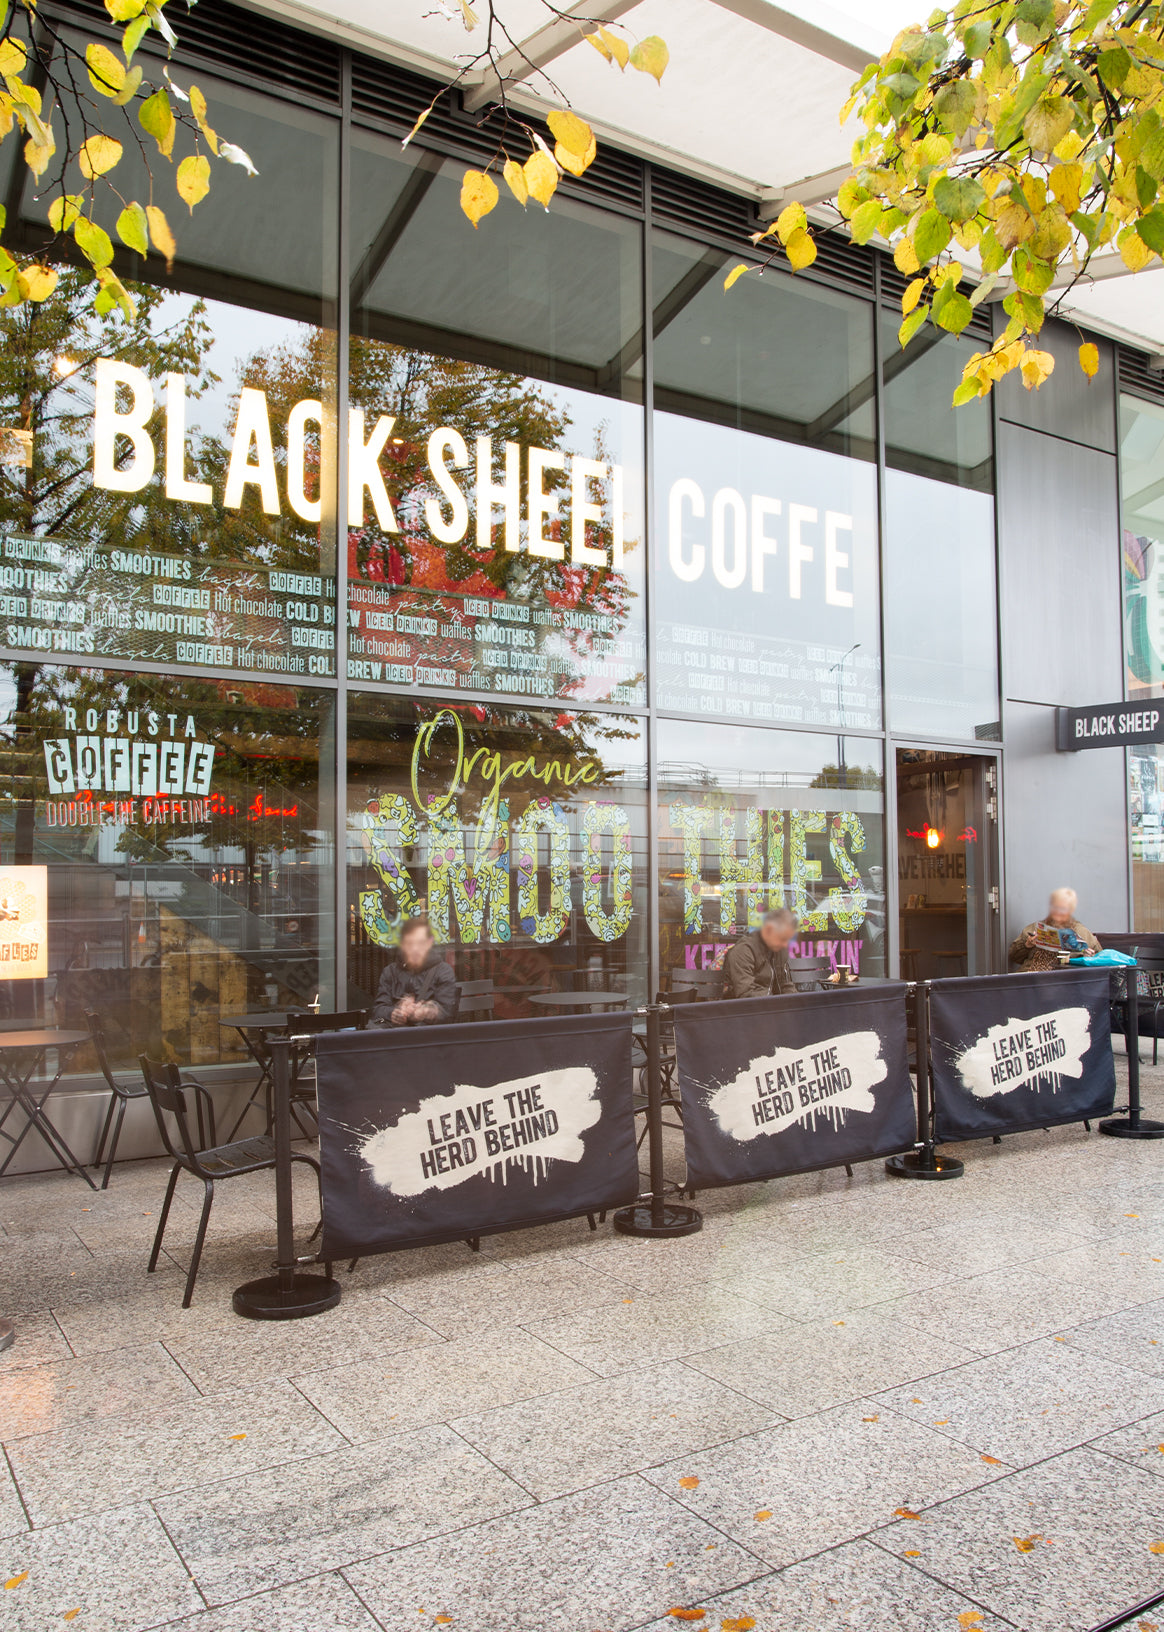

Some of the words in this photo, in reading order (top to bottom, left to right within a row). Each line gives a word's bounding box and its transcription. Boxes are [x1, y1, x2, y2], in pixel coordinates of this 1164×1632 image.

[93, 357, 399, 533] BLACK
[110, 550, 192, 580] SMOOTHIES
[196, 566, 266, 594] bagels
[269, 572, 322, 596] COFFEE
[0, 565, 68, 594] OOTHIES
[153, 584, 211, 610] COFFEE
[214, 592, 232, 613] Hot
[234, 595, 283, 618] chocolate
[286, 601, 319, 622] COLD
[365, 611, 394, 631] ICED
[396, 615, 437, 636] DRINKS
[441, 621, 472, 641] waffles
[475, 624, 536, 647] SMOOTHIES
[30, 598, 86, 624] DRINKS
[90, 606, 132, 629] waffles
[134, 610, 214, 637] SMOOTHIES
[220, 623, 287, 650] bagels
[394, 599, 461, 622] pastry
[463, 598, 490, 618] ICED
[491, 601, 530, 623] DRINKS
[533, 608, 562, 628] waffles
[563, 611, 619, 633] SMOOTHIES
[7, 625, 95, 652] SMOOTHIES
[97, 638, 173, 661] bagels
[176, 641, 233, 666] COFFEE
[238, 647, 254, 667] Hot
[257, 650, 304, 672] chocolate
[308, 655, 336, 675] COL
[350, 634, 364, 653] Hot
[366, 638, 411, 658] chocolate
[414, 650, 480, 672] pastry
[482, 649, 508, 667] ICED
[510, 651, 548, 671] DRINKS
[347, 660, 382, 680] BREW
[385, 664, 413, 683] ICED
[416, 666, 456, 687] DRINKS
[459, 671, 490, 689] waffles
[495, 674, 554, 696] SMOOTHIES
[65, 707, 196, 738] ROBUSTA
[1075, 715, 1115, 738] BLACK
[1119, 710, 1159, 735] SHEEP
[43, 735, 216, 796] COFFEE
[411, 709, 599, 854] Organic
[46, 800, 107, 827] DOUBLE
[110, 801, 139, 826] THE
[143, 799, 212, 825] CAFFEINE
[990, 1057, 1022, 1086] HERD
[1026, 1038, 1066, 1071] BEHIND
[992, 1029, 1033, 1062] LEAVE
[1035, 1019, 1058, 1044] THE
[751, 1091, 794, 1126] HERD
[798, 1067, 852, 1108] BEHIND
[755, 1059, 806, 1098] LEAVE
[810, 1046, 840, 1076] THE
[427, 1099, 497, 1146] LEAVE
[503, 1084, 545, 1119] THE
[420, 1136, 478, 1179] HERD
[484, 1109, 559, 1157] BEHIND
